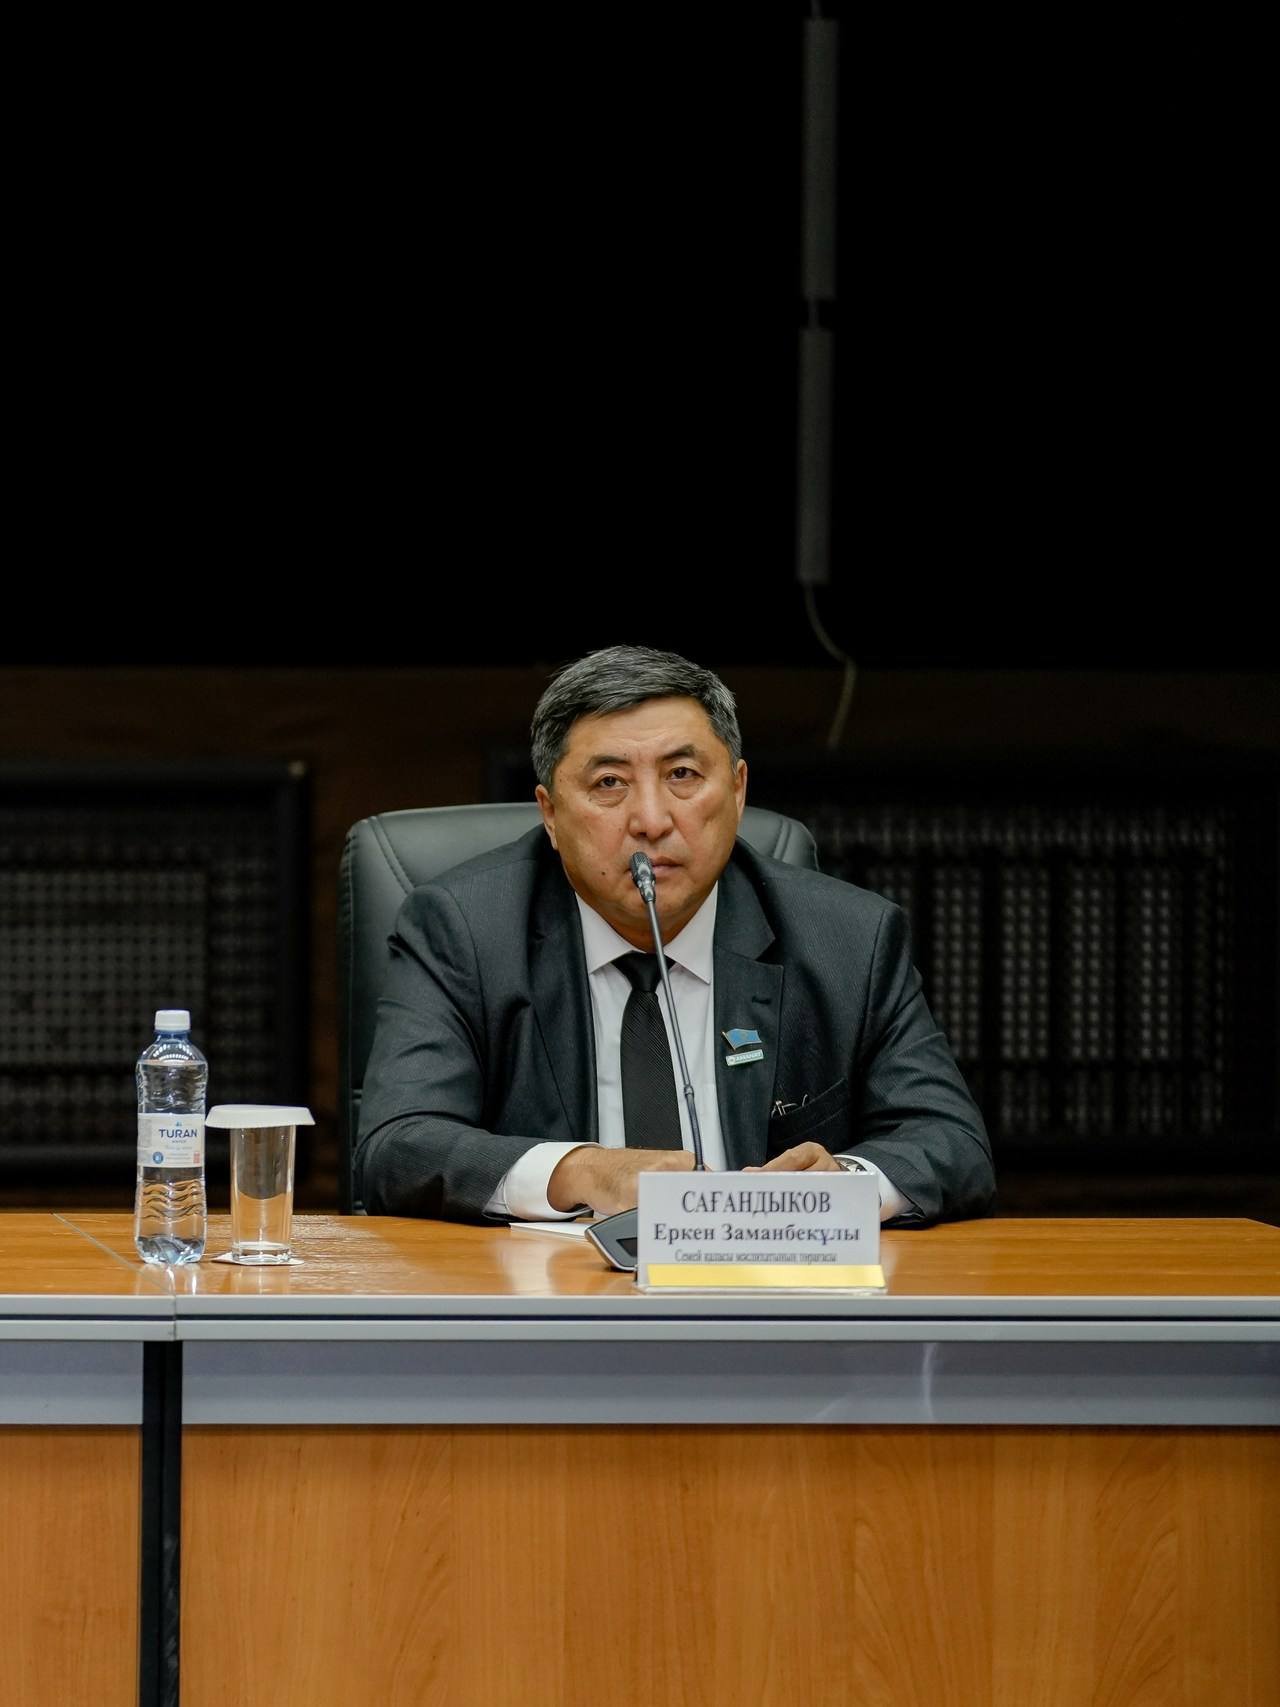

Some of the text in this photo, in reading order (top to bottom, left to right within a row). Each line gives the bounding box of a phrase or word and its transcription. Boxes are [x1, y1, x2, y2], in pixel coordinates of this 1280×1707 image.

[158, 1128, 198, 1138] TURAN
[681, 1190, 831, 1217] САҒАНДЫКОВ
[653, 1223, 860, 1245] Еркен Заманбекұлы
